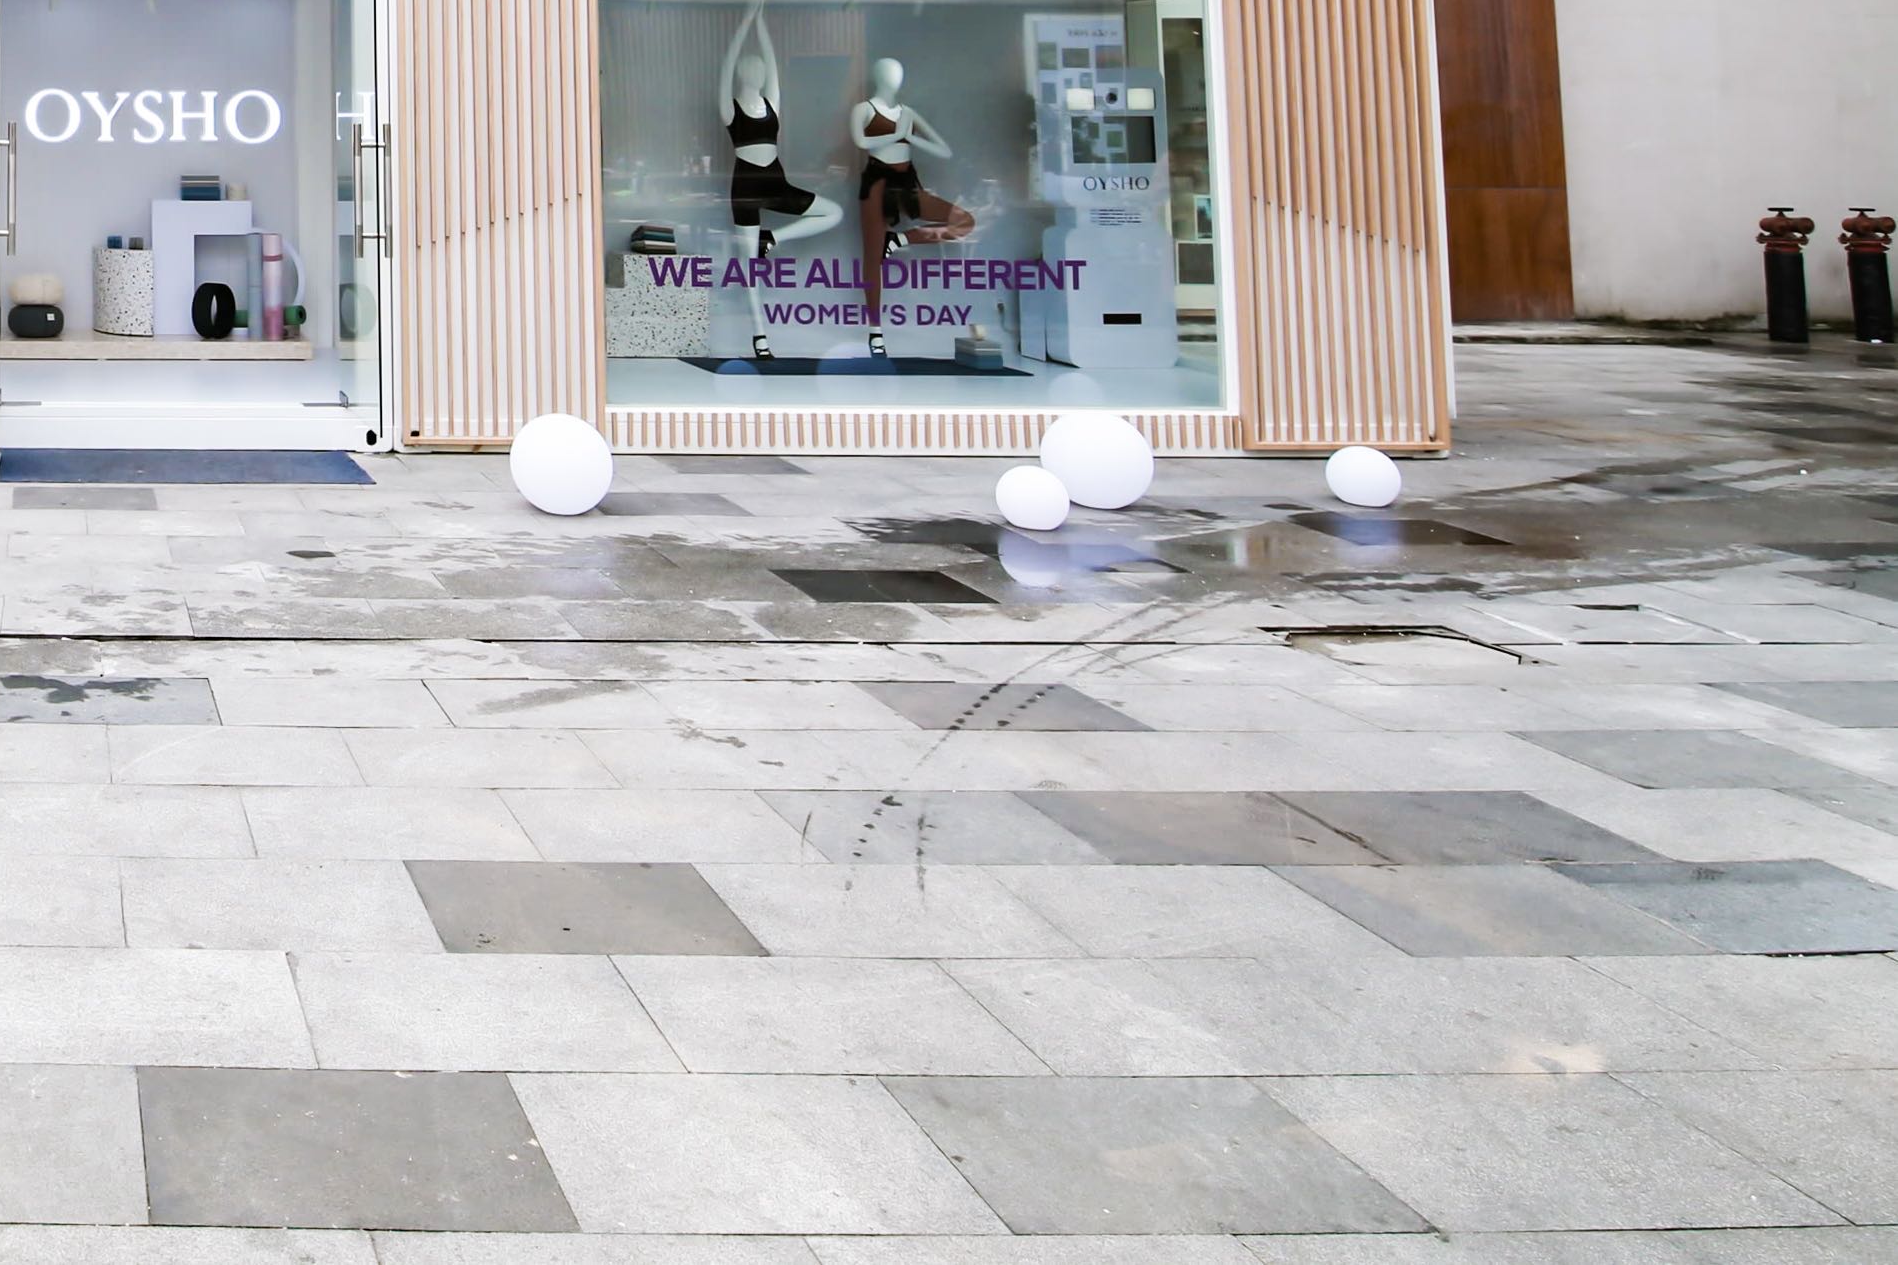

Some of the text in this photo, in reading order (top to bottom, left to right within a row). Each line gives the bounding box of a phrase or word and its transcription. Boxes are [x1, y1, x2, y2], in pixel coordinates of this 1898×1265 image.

[24, 88, 282, 145] OYSHO
[1083, 176, 1150, 191] OYSHO
[648, 257, 1087, 290] WE ARE ALL DIFFERENT
[763, 303, 972, 326] WOMEN'S DAY
